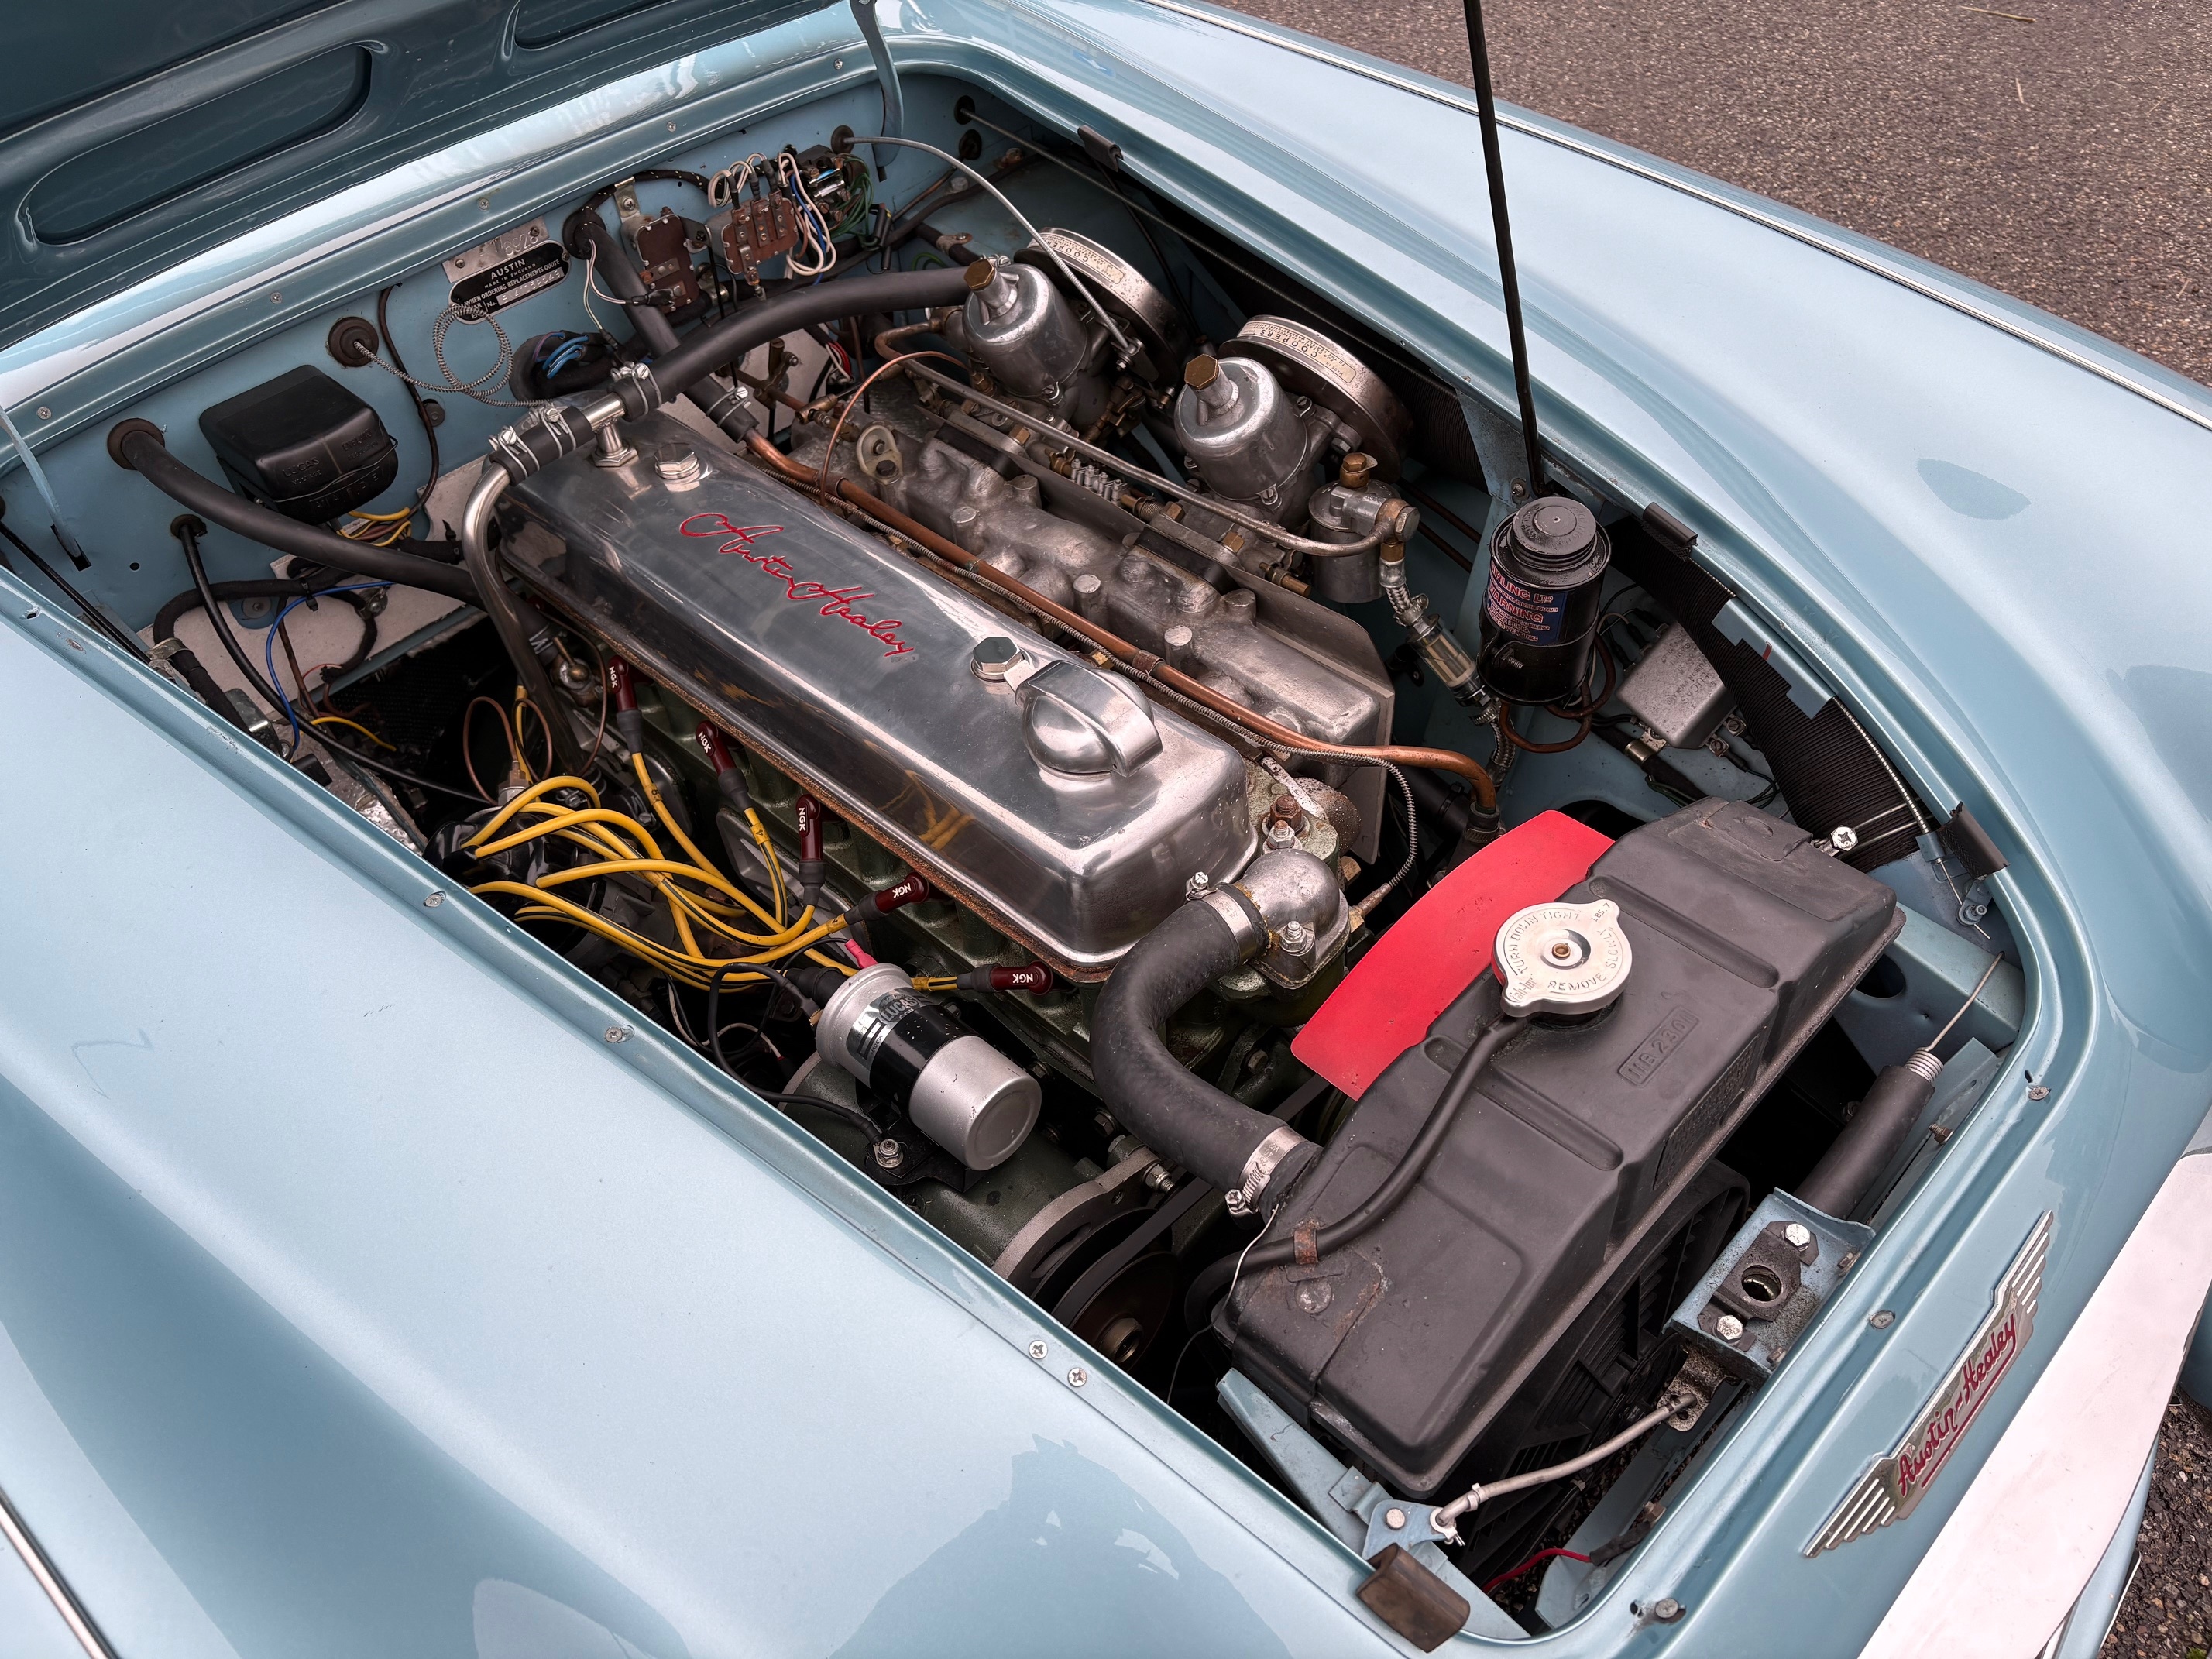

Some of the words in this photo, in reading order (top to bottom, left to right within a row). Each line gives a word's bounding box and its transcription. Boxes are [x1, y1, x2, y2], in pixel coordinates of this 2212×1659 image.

[1045, 239, 1088, 263] COOPE
[481, 283, 507, 299] ORDERING
[507, 266, 544, 288] REPLACEMENTS
[544, 259, 561, 271] QUOTE
[484, 280, 500, 289] MADE
[510, 263, 537, 277] ENGLAND
[491, 258, 526, 280] AUSTIN
[1260, 329, 1317, 357] COOPERS
[282, 456, 320, 477] LUCAS
[786, 581, 915, 657] Healey
[609, 666, 618, 689] NGK
[1680, 672, 1709, 704] LUCAS
[698, 731, 712, 754] NGK
[892, 882, 912, 898] NGK
[1510, 915, 1539, 941] DOWN
[1539, 910, 1581, 922] TIGHT
[1508, 944, 1528, 974] TURN
[1548, 972, 1607, 991] REMOVE
[1596, 929, 1619, 969] SLOWLY
[1012, 973, 1034, 984] NGK
[881, 995, 919, 1022] LUCAS
[1898, 1313, 2017, 1497] Austin-Healey
